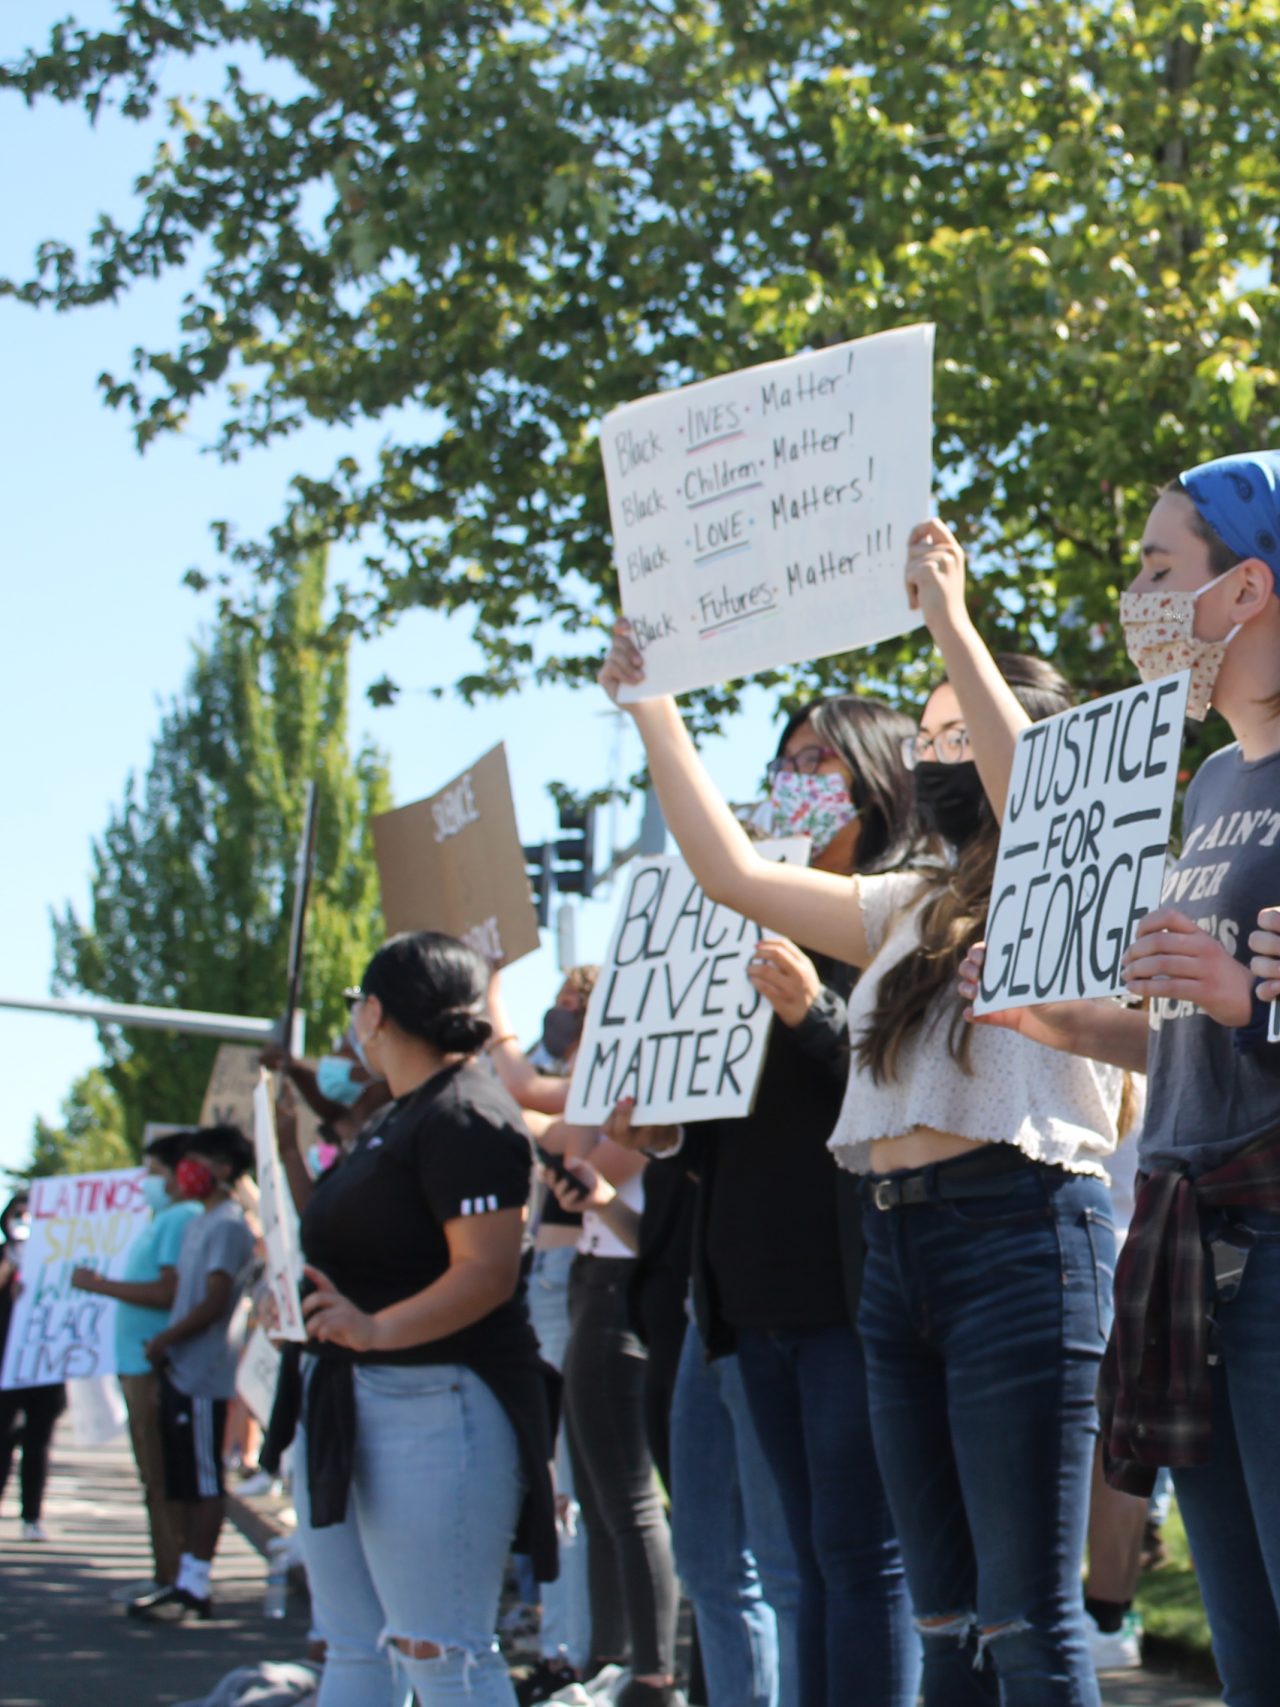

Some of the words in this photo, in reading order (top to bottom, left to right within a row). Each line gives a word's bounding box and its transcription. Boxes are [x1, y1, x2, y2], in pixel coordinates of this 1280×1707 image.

[614, 429, 664, 478] Black
[761, 351, 855, 417] Matter!
[620, 488, 668, 528] Black
[772, 412, 856, 470] Matter!
[626, 544, 671, 584] Black
[694, 510, 744, 553] LOVE
[770, 456, 875, 531] Matters!
[632, 612, 680, 651] Black
[698, 582, 774, 624] Futures
[1010, 680, 1179, 823] JUSTICE
[1043, 800, 1105, 870] FOR
[582, 1023, 754, 1108] MATTER
